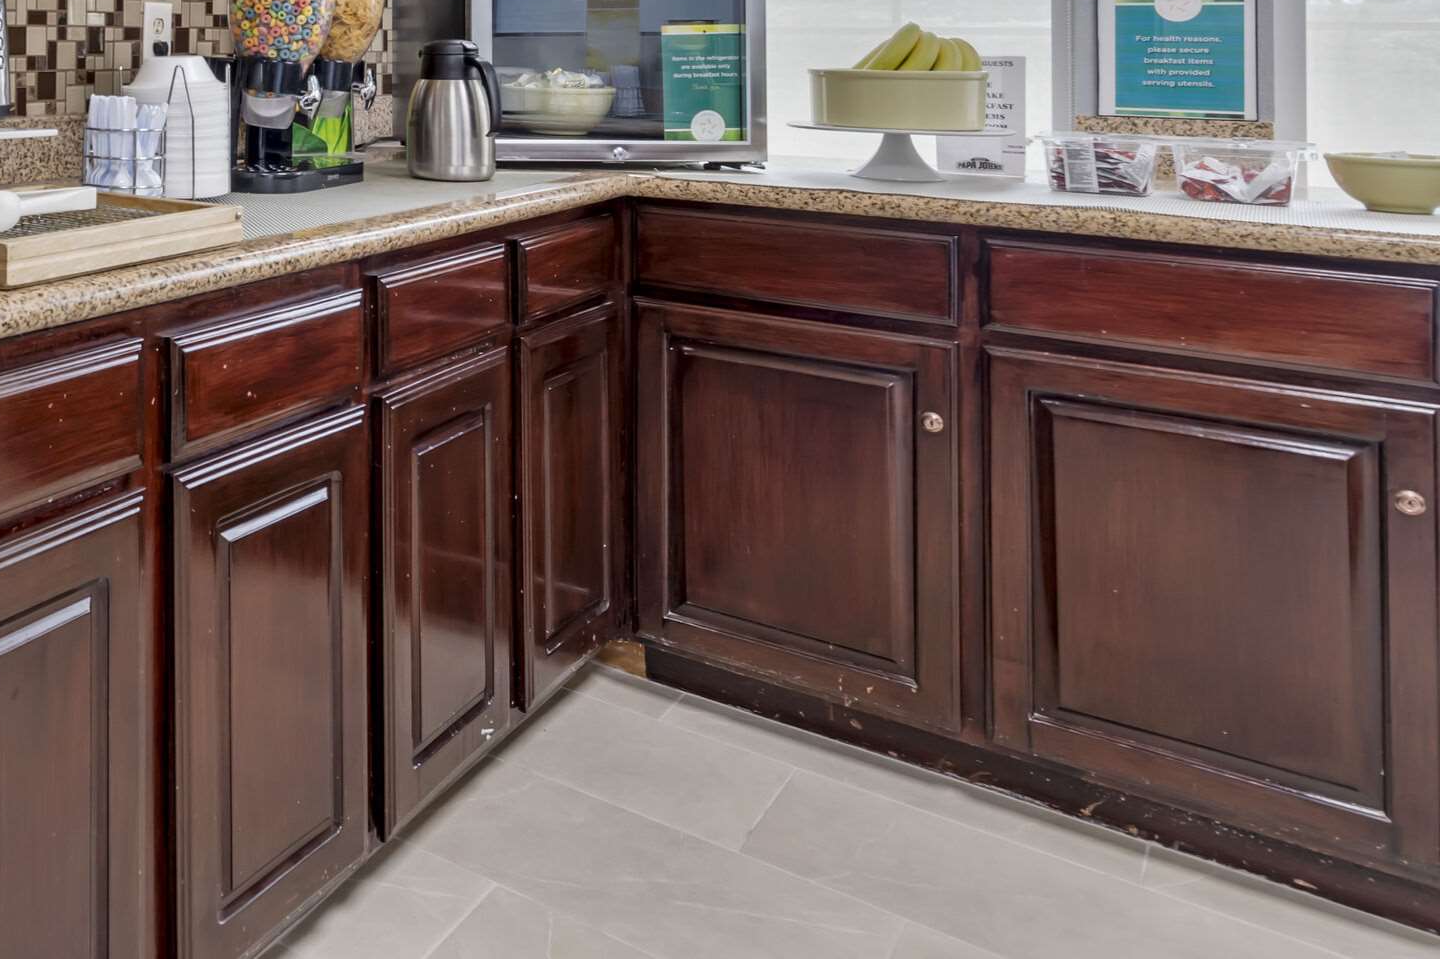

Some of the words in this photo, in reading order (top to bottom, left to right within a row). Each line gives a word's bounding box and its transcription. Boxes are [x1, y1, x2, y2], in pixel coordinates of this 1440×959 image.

[1147, 46, 1177, 54] please
[1143, 56, 1186, 65] breakfast
[1168, 69, 1211, 77] provided
[1142, 80, 1176, 88] serving
